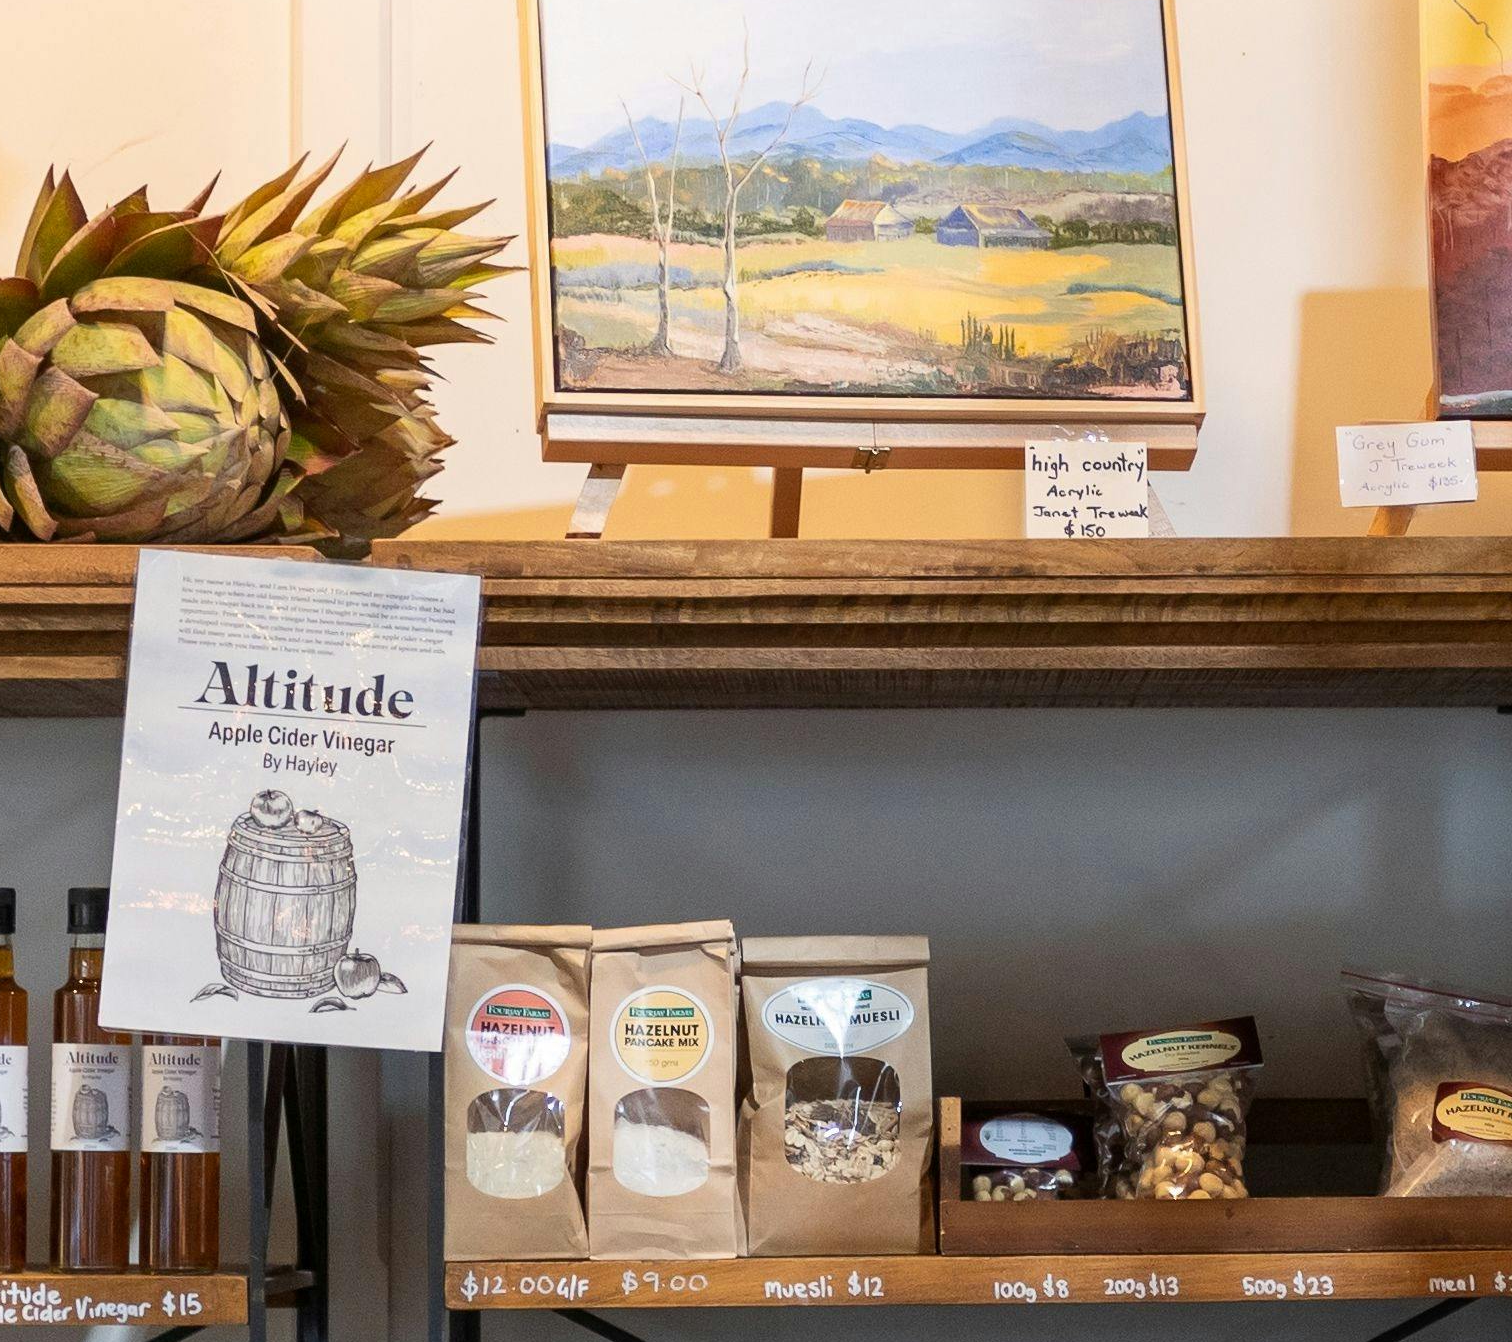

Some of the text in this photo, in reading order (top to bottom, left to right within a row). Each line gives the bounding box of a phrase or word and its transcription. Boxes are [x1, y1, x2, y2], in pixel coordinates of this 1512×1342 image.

[1391, 457, 1457, 472] Treweek
[195, 660, 414, 719] Altitude
[208, 721, 395, 754] Apple Cider Vinegar
[263, 753, 337, 777] By Hayley
[625, 1024, 699, 1037] HAZELNUT
[625, 1038, 698, 1047] PANCAKE MIX
[1445, 1105, 1505, 1123] HAZELNUT
[622, 1271, 708, 1293] $9.00
[848, 1273, 884, 1297] $12
[993, 1281, 1037, 1302] 100g
[1104, 1278, 1145, 1298] 200g
[1242, 1272, 1333, 1299] 500g $23
[22, 1305, 72, 1322] Cider
[76, 1299, 150, 1320] Vinegar
[162, 1291, 202, 1317] $15
